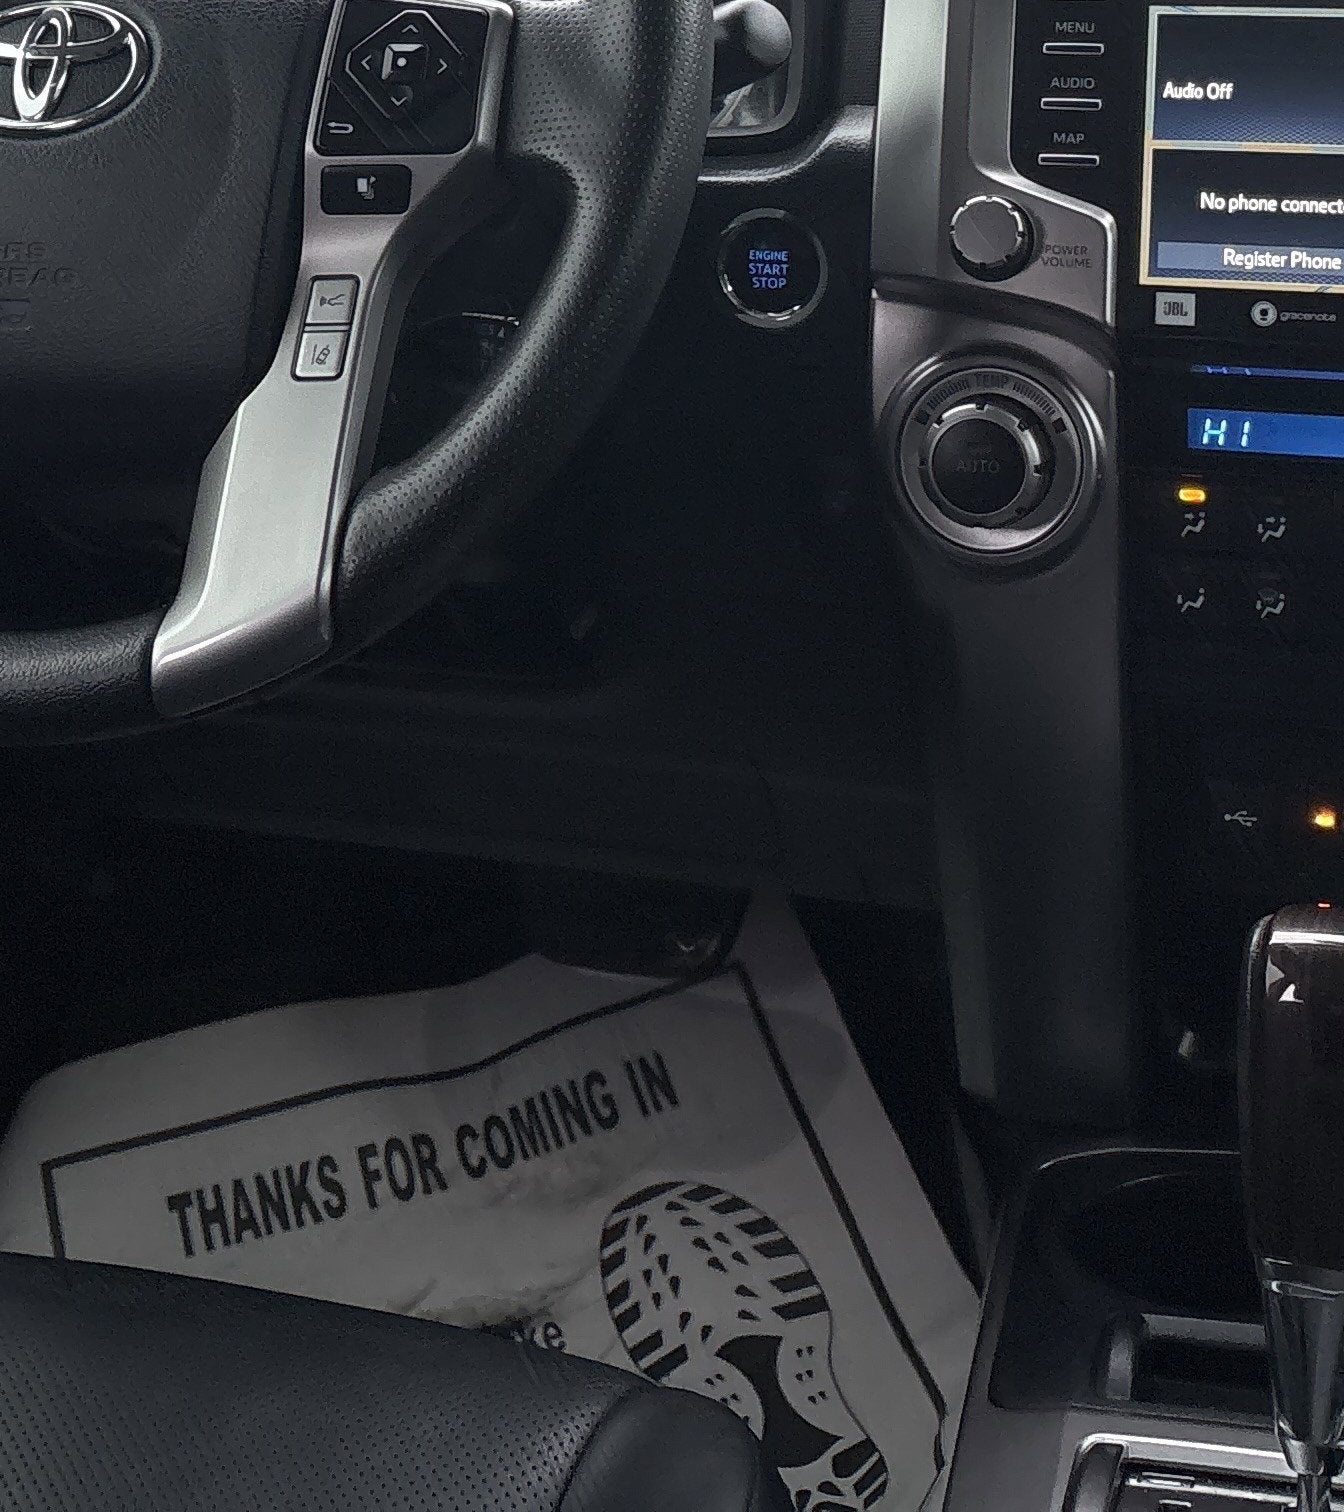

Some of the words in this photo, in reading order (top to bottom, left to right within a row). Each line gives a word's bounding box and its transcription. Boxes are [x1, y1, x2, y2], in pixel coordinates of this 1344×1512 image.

[1056, 21, 1095, 34] MENU
[1050, 76, 1096, 89] AUDIO
[1162, 82, 1204, 100] Audio
[1206, 83, 1234, 100] Off
[1053, 132, 1085, 144] MAP
[1199, 192, 1226, 210] No
[1228, 193, 1278, 213] phone
[749, 249, 788, 261] ENGINE
[1044, 244, 1088, 255] POWER
[1042, 256, 1092, 268] VOLUME
[1222, 247, 1288, 270] Register
[1290, 250, 1342, 270] Phone
[748, 263, 789, 276] START
[752, 277, 787, 289] STOP
[1163, 301, 1188, 317] JBL
[166, 1153, 347, 1259] THANKS
[354, 1130, 450, 1212] FOR
[453, 1070, 621, 1182] COMING
[617, 1051, 683, 1119] IN
